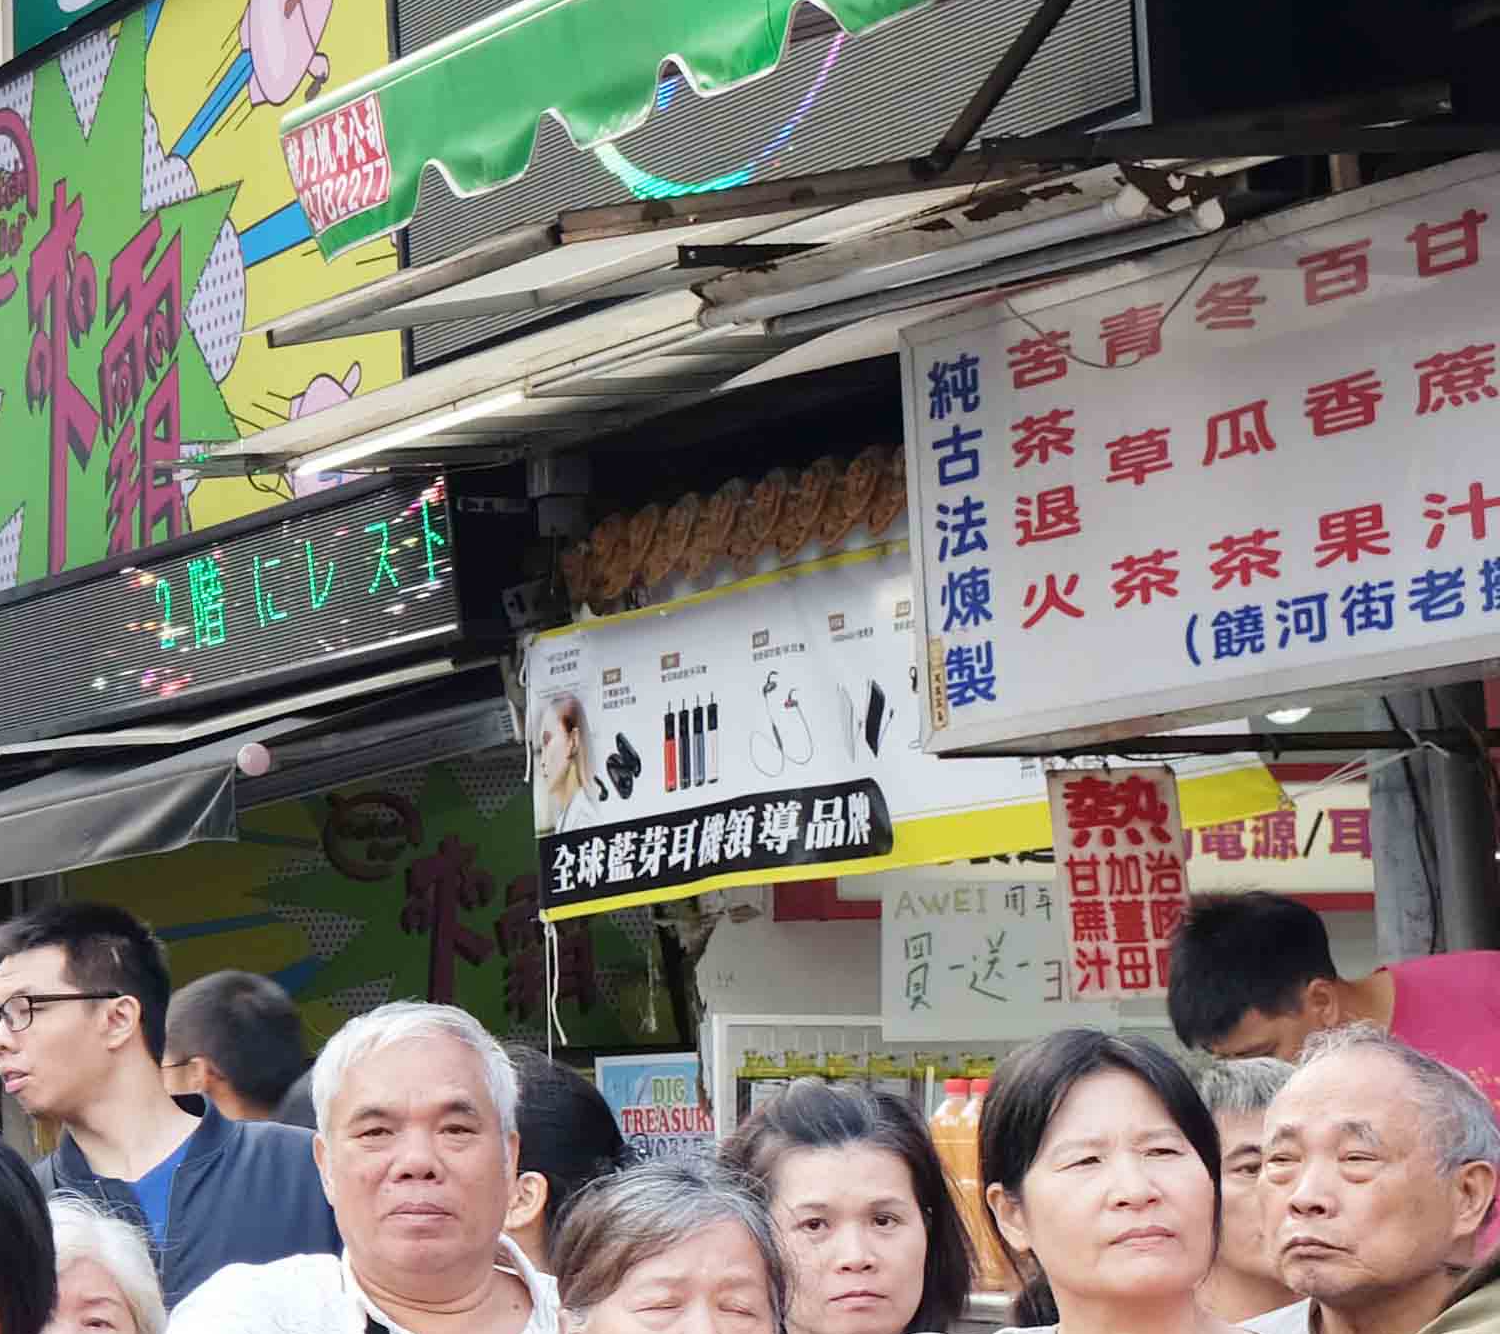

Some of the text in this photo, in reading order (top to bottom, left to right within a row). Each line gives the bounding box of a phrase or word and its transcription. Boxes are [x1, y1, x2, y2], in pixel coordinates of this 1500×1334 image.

[927, 352, 997, 709] 純古法煉製
[1007, 329, 1085, 631] 苦茶退火
[1098, 301, 1181, 609] 青草茶
[1194, 274, 1281, 591] 冬瓜茶
[1297, 237, 1391, 568] 百香果
[551, 790, 871, 894] 全球藍芽耳機領導品牌
[894, 888, 989, 921] AWEI
[1062, 773, 1171, 850] 熱
[651, 1076, 687, 1103] DIG
